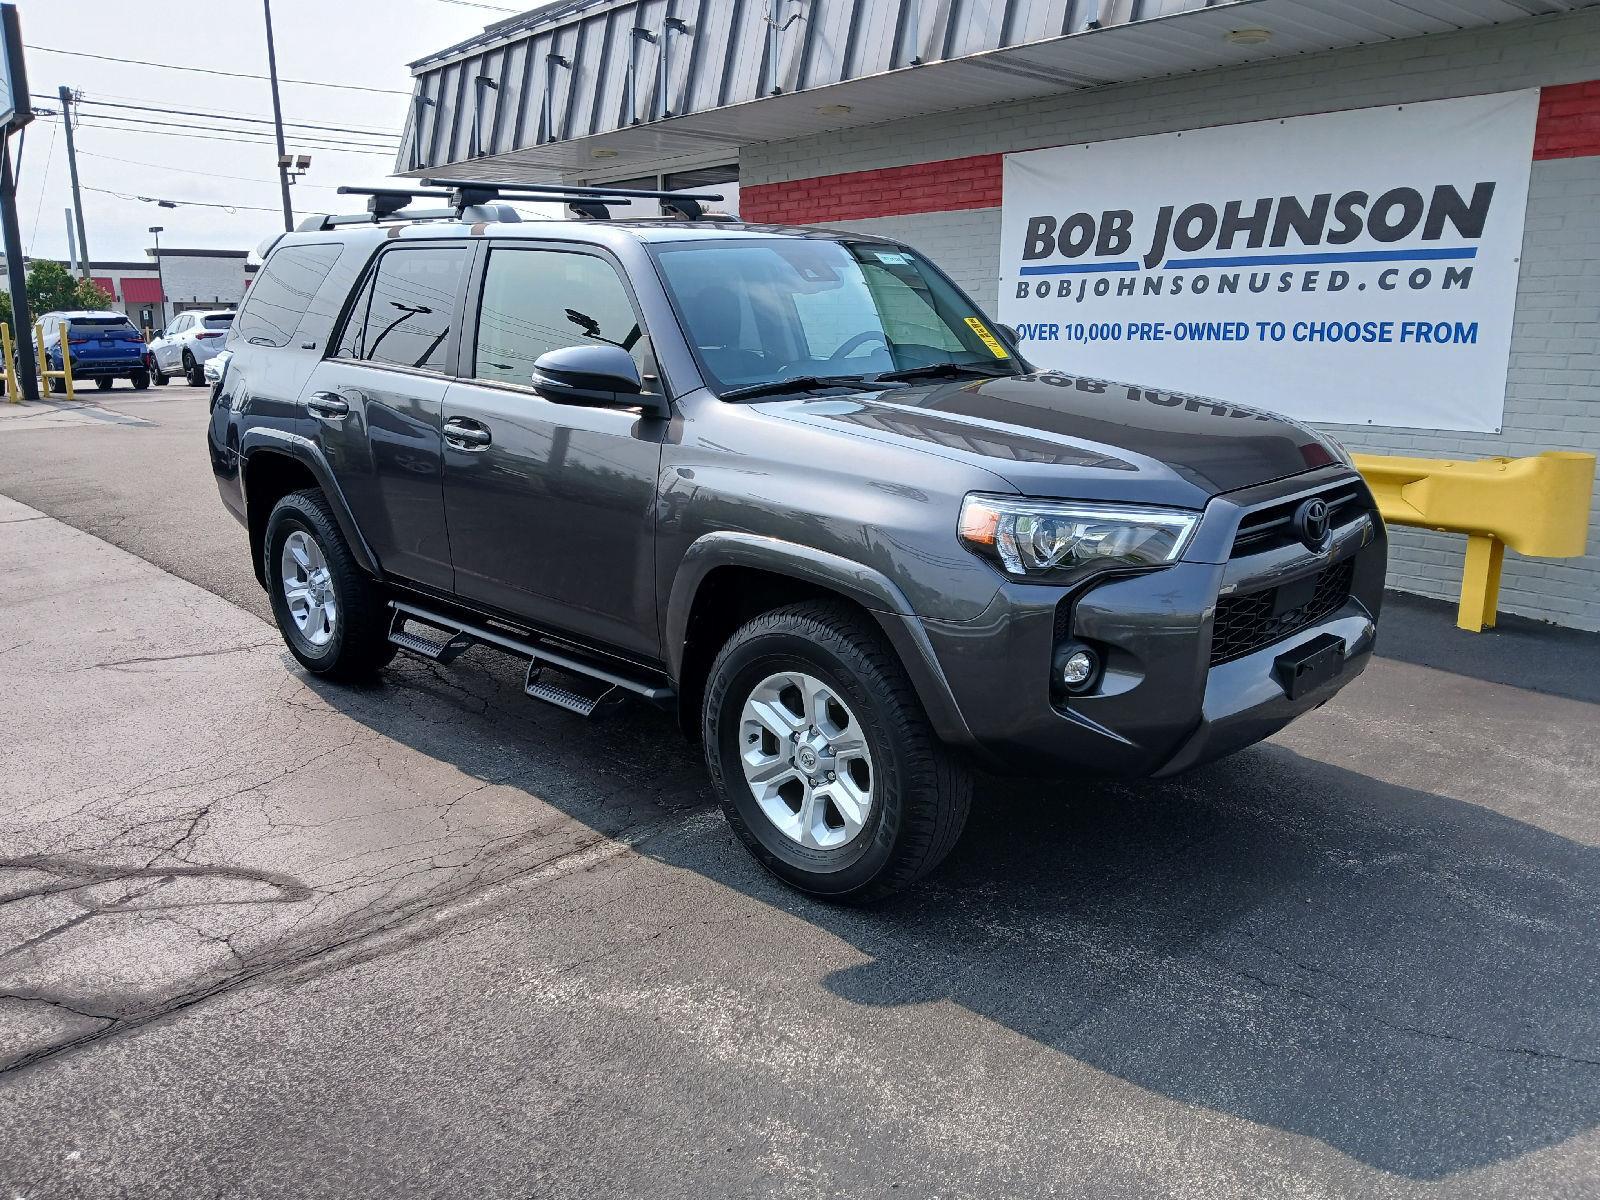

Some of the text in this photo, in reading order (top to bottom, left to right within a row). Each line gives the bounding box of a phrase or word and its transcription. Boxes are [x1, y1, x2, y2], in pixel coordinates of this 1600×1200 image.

[1021, 182, 1497, 270] BOB JOHNSON
[1014, 266, 1474, 303] BOBJOHNSONUSED.COM
[1015, 323, 1060, 341] OVER
[1065, 323, 1122, 345] 10,000
[1126, 321, 1250, 342] PRE-OWNED
[1255, 321, 1287, 342] TO
[1292, 321, 1394, 343] CHOOSE
[1400, 321, 1479, 344] FROM
